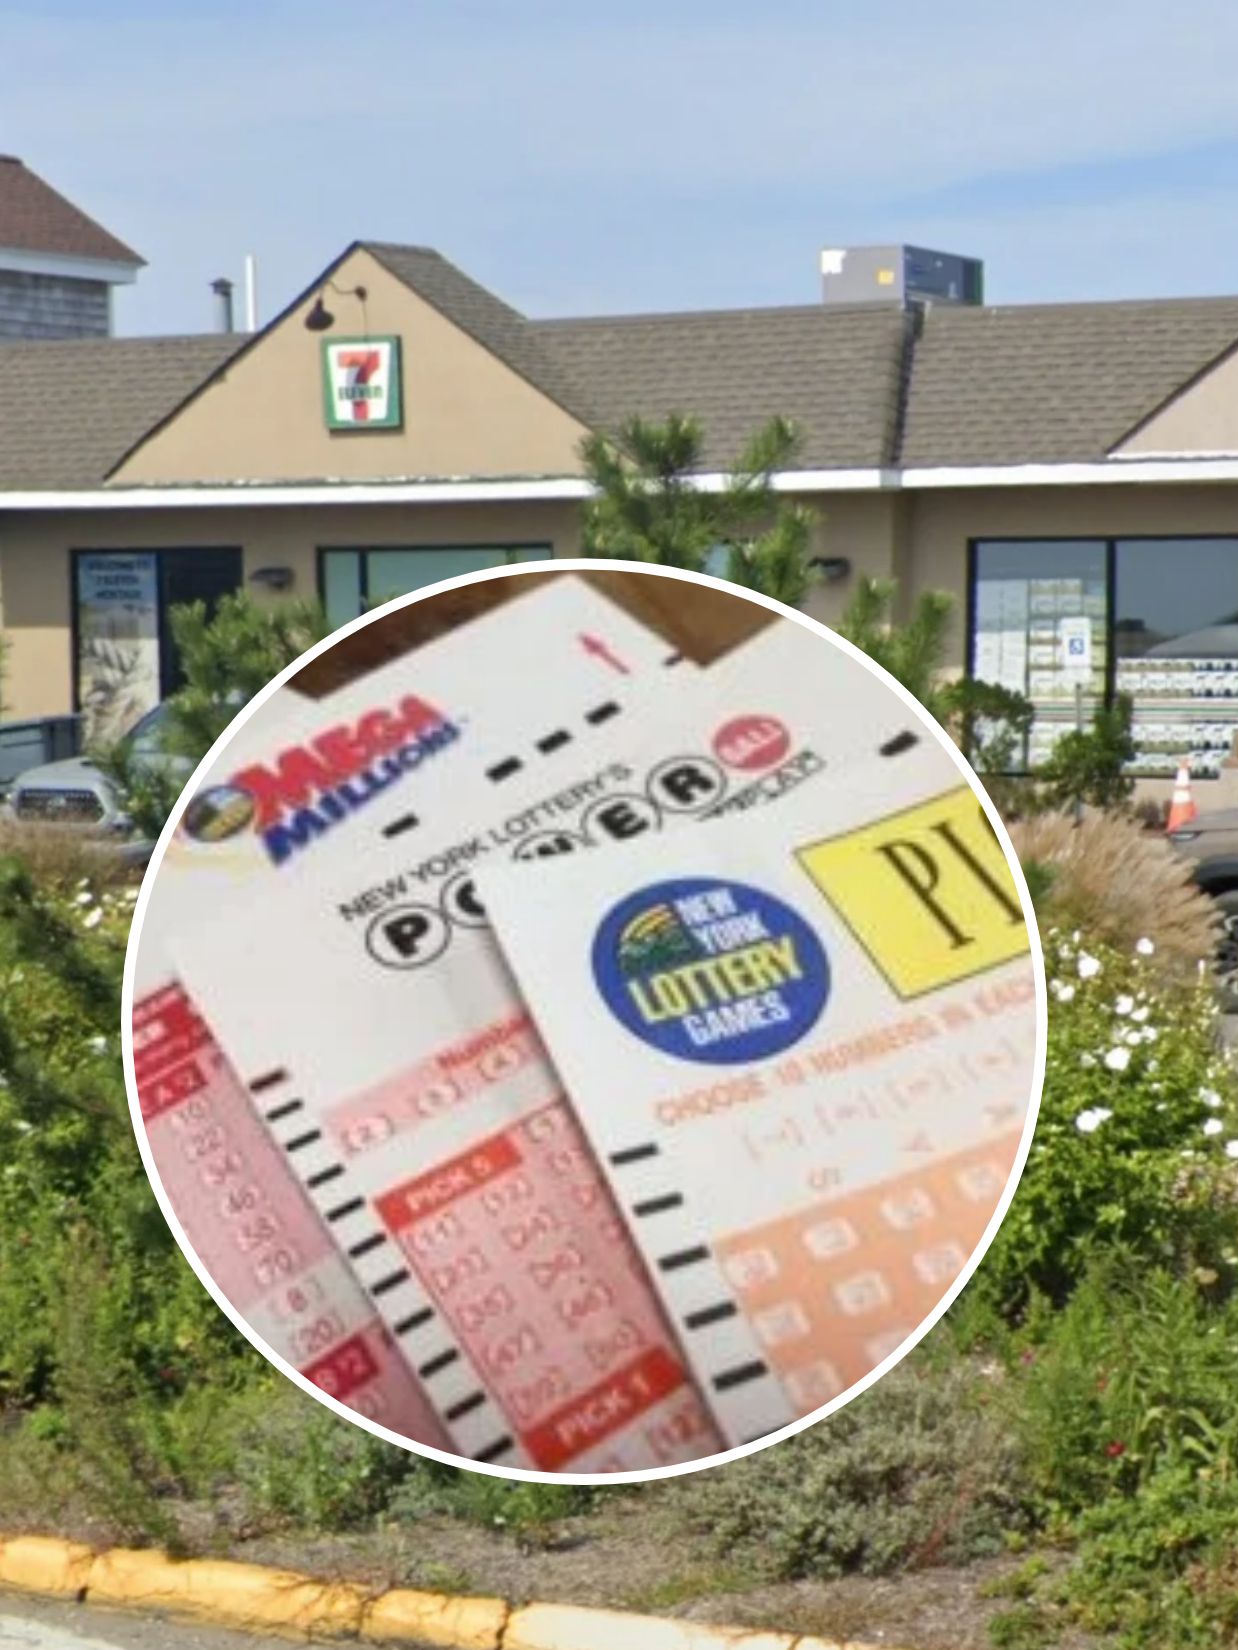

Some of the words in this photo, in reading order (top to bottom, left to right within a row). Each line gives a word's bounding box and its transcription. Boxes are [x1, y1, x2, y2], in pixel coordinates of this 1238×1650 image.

[338, 351, 380, 421] 7
[231, 695, 444, 833] MEGA
[336, 875, 408, 922] NEW
[409, 832, 490, 884] YORK
[489, 763, 634, 845] LOTTERY'S
[674, 888, 738, 928] NEW
[876, 804, 1026, 951] PI
[692, 910, 770, 954] YORK
[627, 934, 803, 1024] LOTTERY
[680, 989, 791, 1046] GAMES
[655, 1074, 770, 1128] CHOOSE
[405, 1166, 471, 1214] PICK
[555, 1387, 632, 1448] PICK
